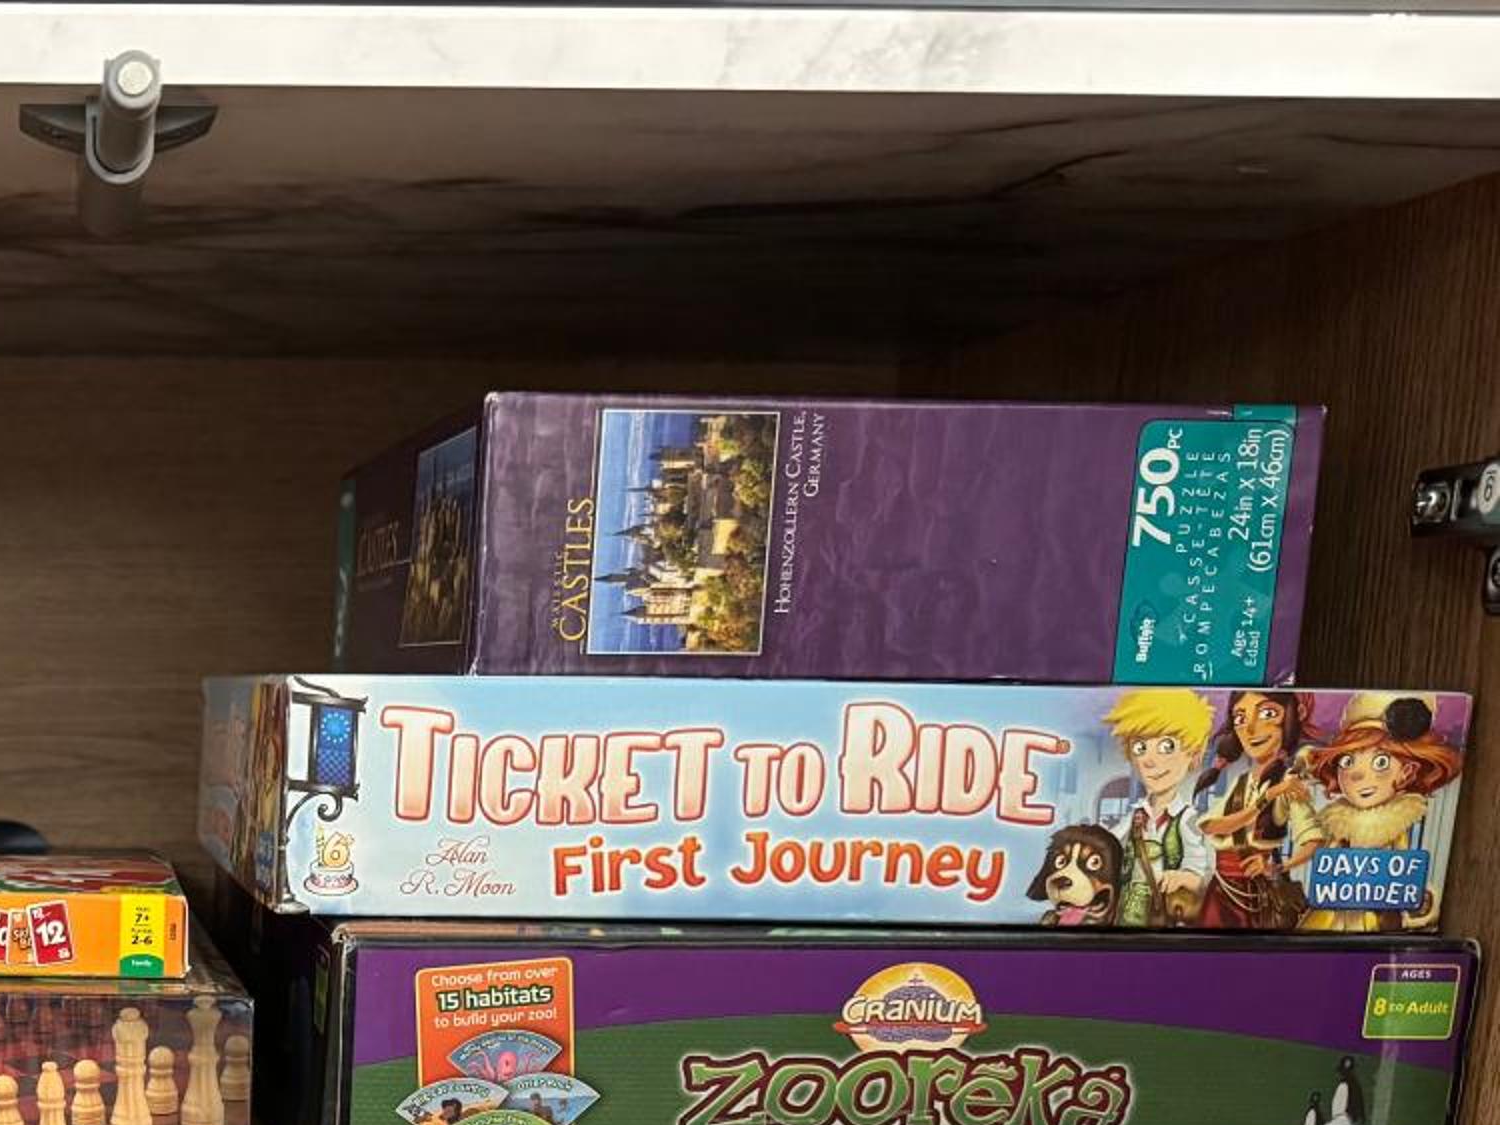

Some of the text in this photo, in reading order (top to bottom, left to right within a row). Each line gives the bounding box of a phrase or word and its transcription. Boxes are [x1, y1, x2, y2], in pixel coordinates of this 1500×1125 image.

[804, 413, 826, 497] GERMANY
[1237, 429, 1261, 468] 18in
[1260, 429, 1288, 488] 46cm)
[1132, 428, 1183, 546] 750 PC
[1176, 452, 1198, 552] PUZZLE
[1228, 496, 1254, 540] 24in
[1247, 514, 1276, 571] (61cm
[559, 497, 593, 641] CASTLES
[1194, 452, 1230, 673] ROMPECABEZAS
[1241, 597, 1258, 625] 14+
[1232, 630, 1246, 656] Age
[1245, 632, 1260, 666] Edad
[381, 705, 724, 825] TICKET
[840, 702, 1060, 824] RIDE
[426, 835, 488, 866] Alan
[554, 832, 1005, 902] First Journey
[1318, 855, 1423, 877] DAYS OF
[400, 869, 515, 898] R. Moon
[35, 922, 67, 947] 12
[431, 966, 559, 988] Choose from over
[1402, 969, 1431, 979] AGES
[438, 985, 553, 1012] 15 habitats
[1373, 997, 1449, 1017] 8 to Adult
[434, 1008, 557, 1029] to build your zoo!
